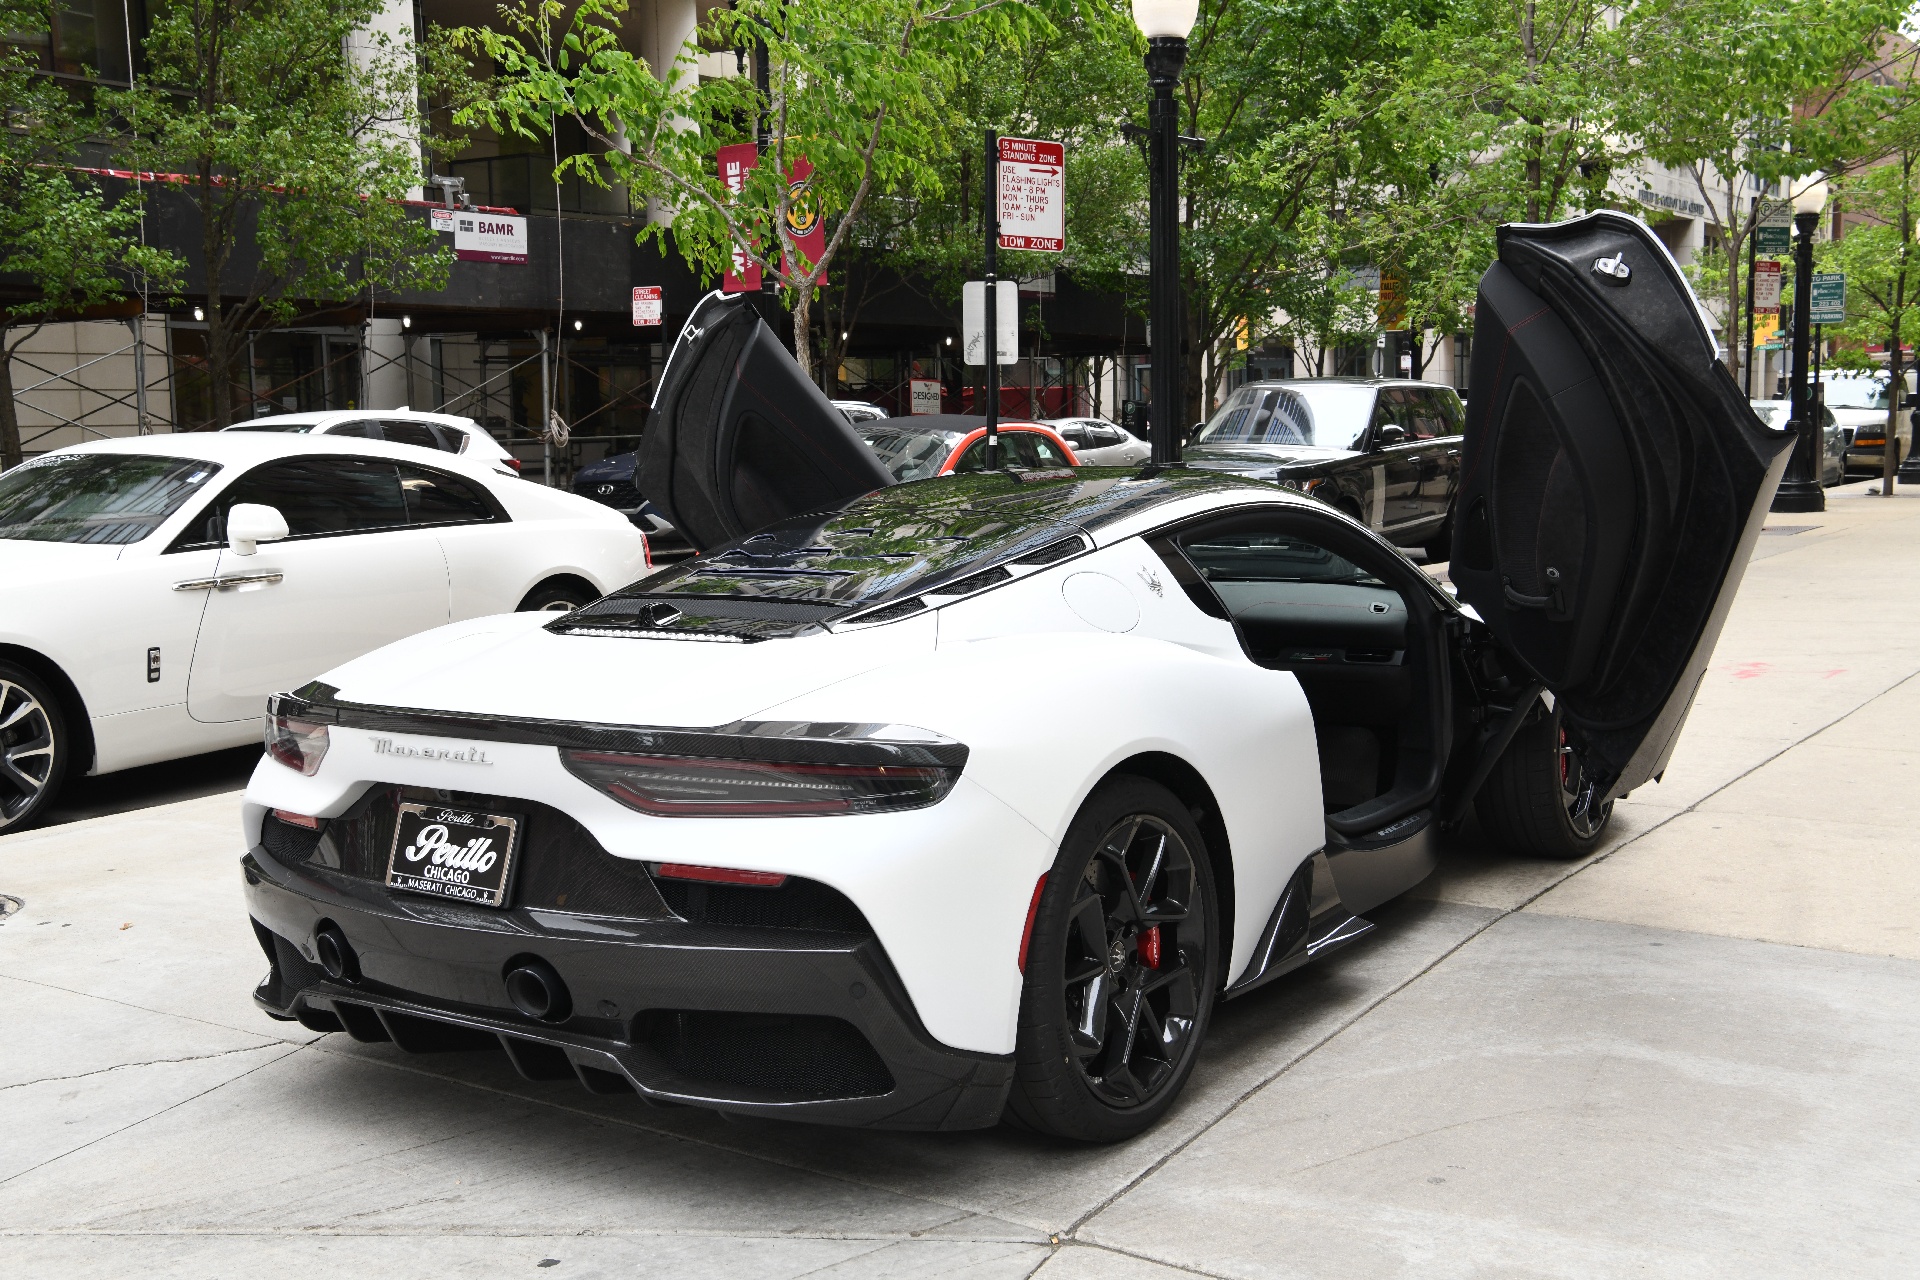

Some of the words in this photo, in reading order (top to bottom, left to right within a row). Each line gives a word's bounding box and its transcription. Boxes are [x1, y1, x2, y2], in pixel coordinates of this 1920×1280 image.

[1003, 141, 1009, 149] 15
[1012, 142, 1036, 152] MINUTE
[1002, 151, 1035, 161] STANDING
[1039, 154, 1056, 163] ZONE
[1003, 166, 1016, 174] USE
[1003, 175, 1035, 185] FLASHING
[1037, 178, 1060, 188] LIGHTS
[1003, 193, 1017, 201] MON
[1026, 195, 1048, 205] THURS
[1003, 212, 1014, 220] FRI
[1021, 213, 1035, 221] SUN
[479, 222, 514, 236] BAMR
[1003, 236, 1024, 248] TOW
[1031, 238, 1057, 250] ZONE
[913, 392, 939, 400] DESIGNED
[368, 736, 493, 765] Maserati
[437, 810, 475, 824] Perillo
[405, 825, 497, 873] Perillo
[424, 865, 470, 883] CHICAGO
[407, 878, 442, 892] MASERATI
[445, 884, 477, 899] CHICAGO
